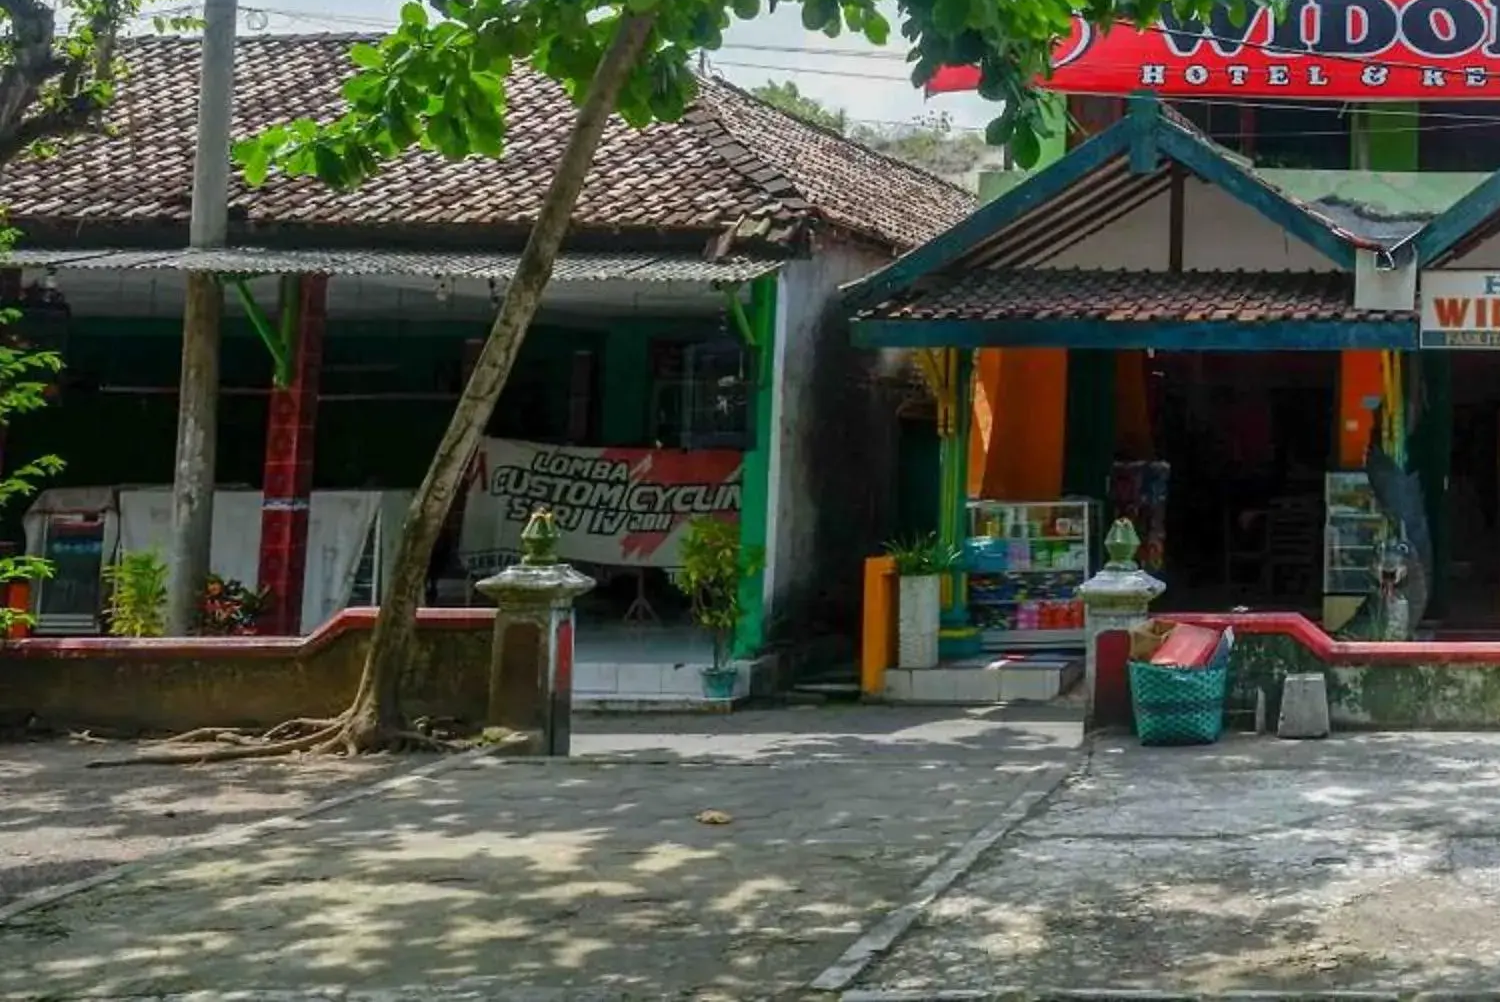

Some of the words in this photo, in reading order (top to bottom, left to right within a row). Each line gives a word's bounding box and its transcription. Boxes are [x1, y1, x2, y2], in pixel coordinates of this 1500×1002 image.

[1140, 64, 1328, 86] HOTEL
[1361, 64, 1391, 85] &
[532, 451, 630, 483] LOMBA
[491, 466, 627, 510] CUSTOM
